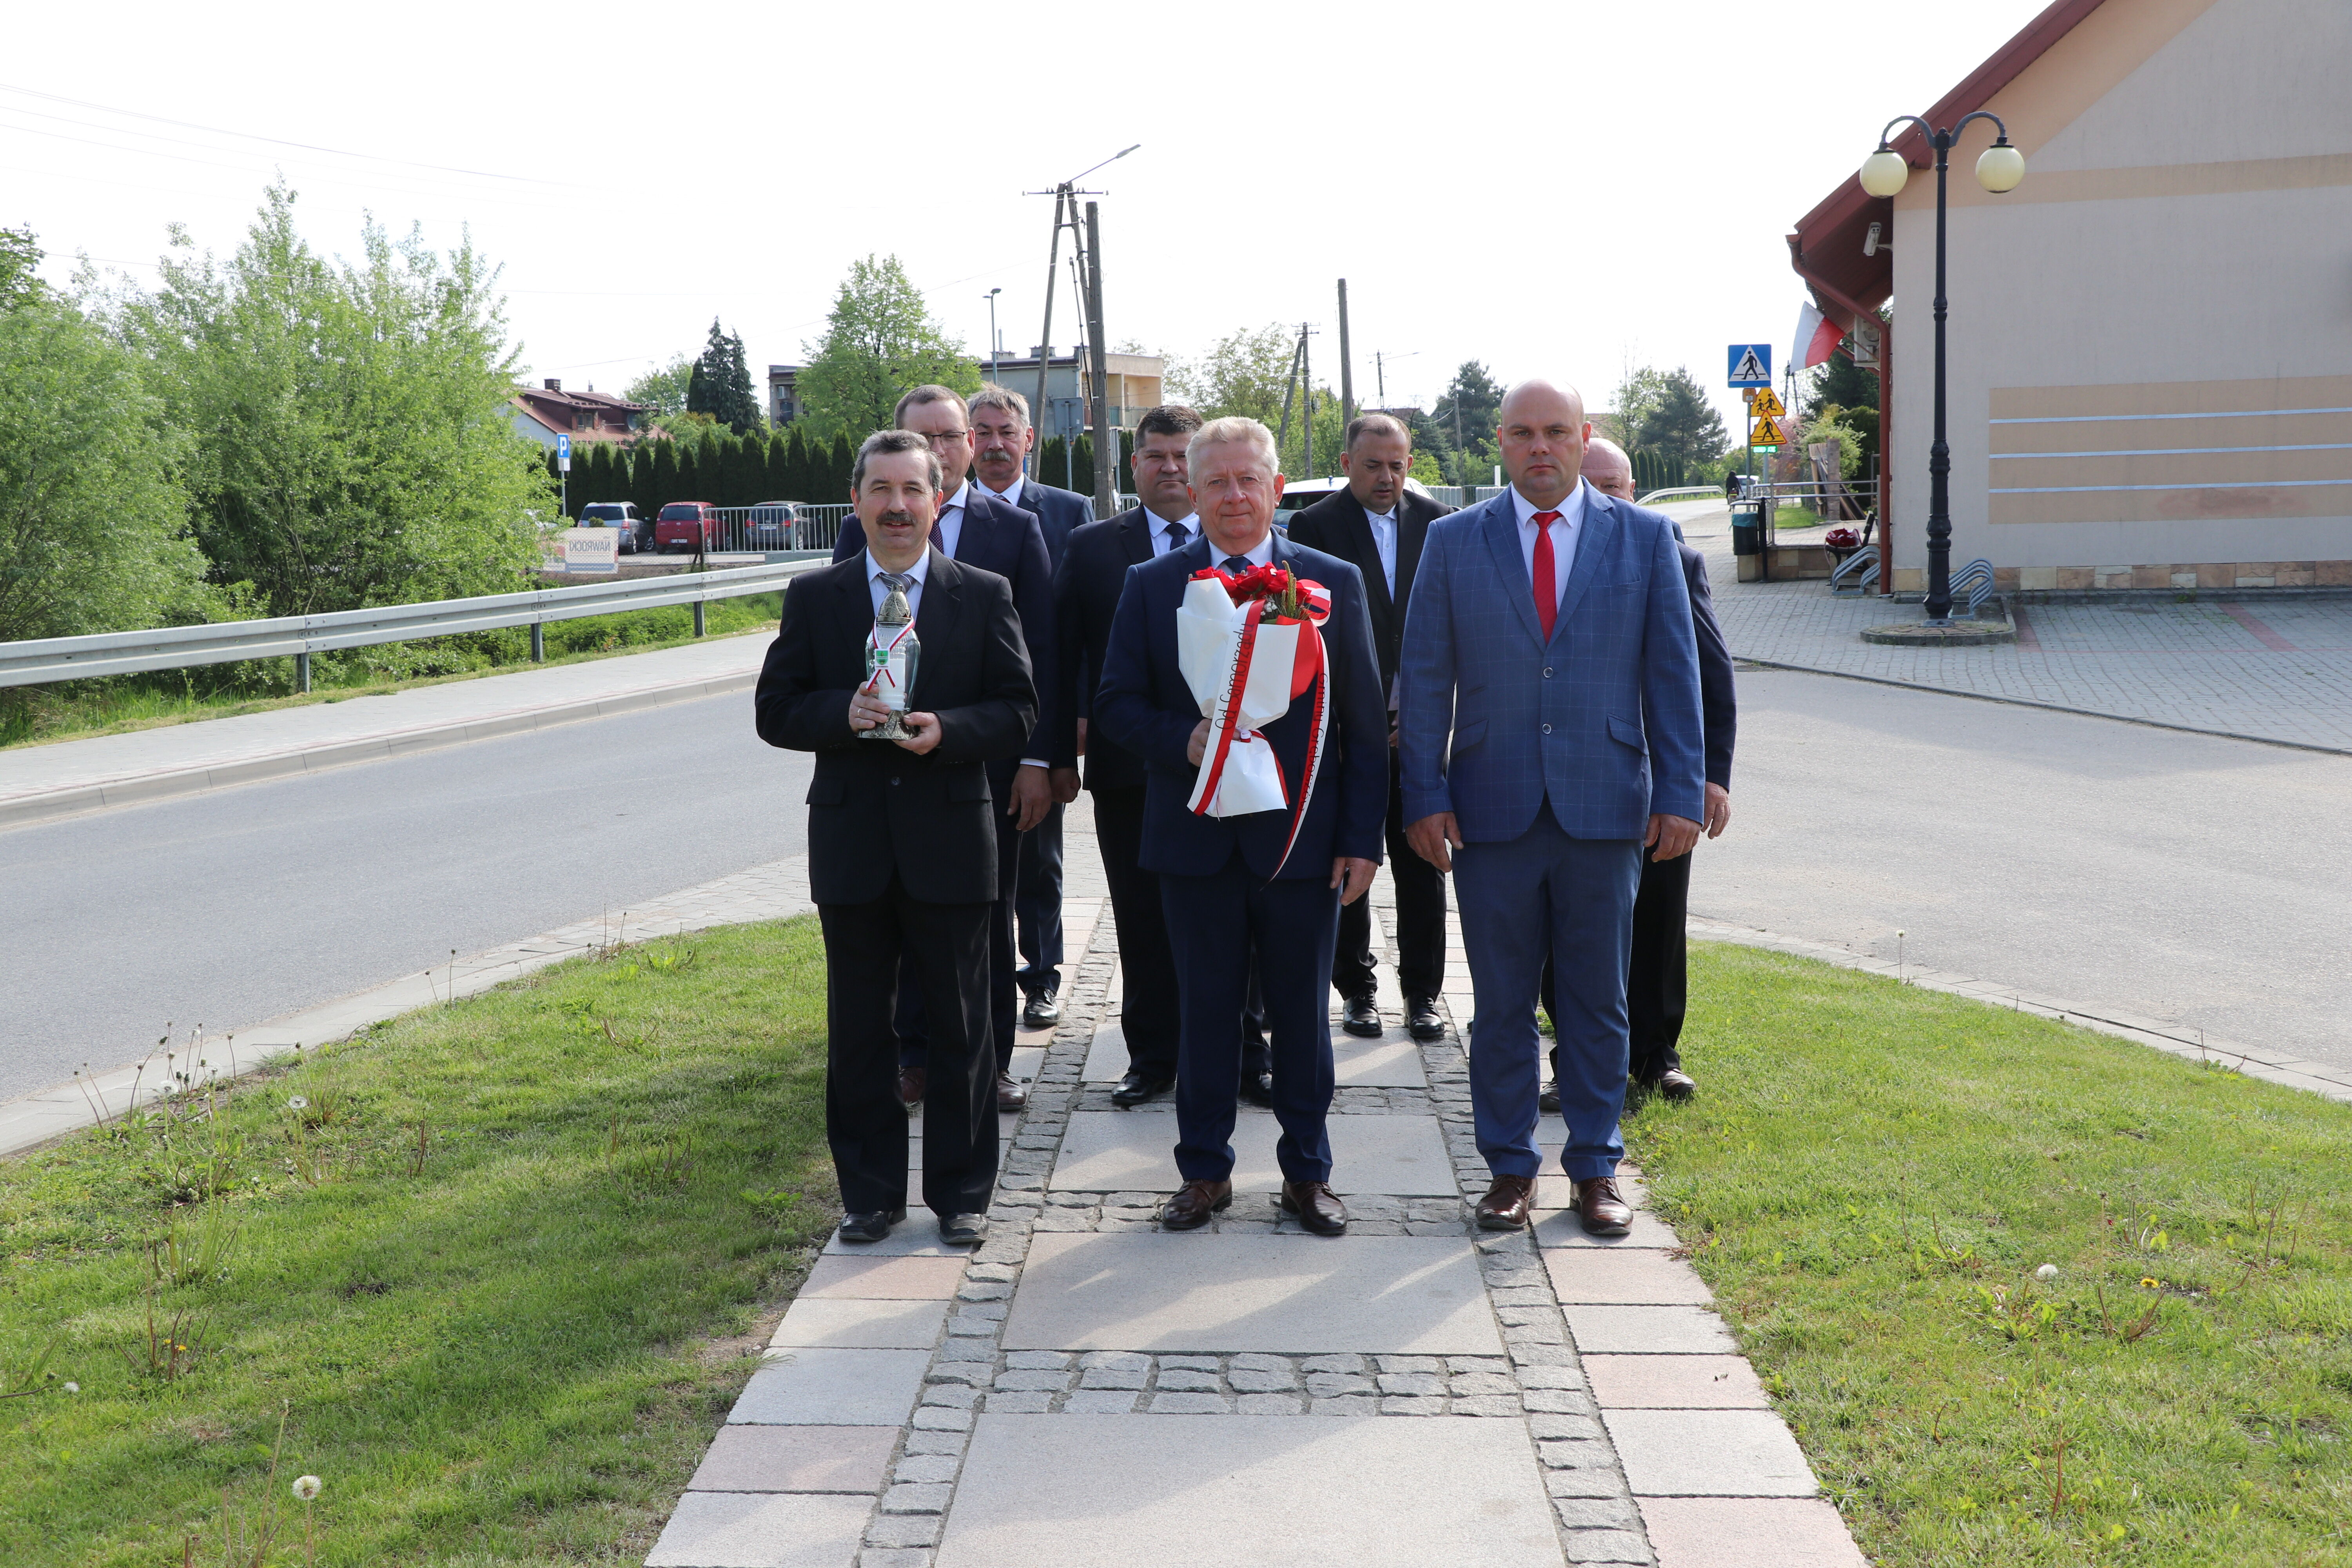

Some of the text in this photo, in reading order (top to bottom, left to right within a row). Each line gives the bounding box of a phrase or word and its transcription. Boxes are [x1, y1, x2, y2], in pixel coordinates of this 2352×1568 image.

[559, 437, 567, 456] P
[1215, 624, 1254, 729] Od Samorządu
[1313, 673, 1328, 722] Gminy
